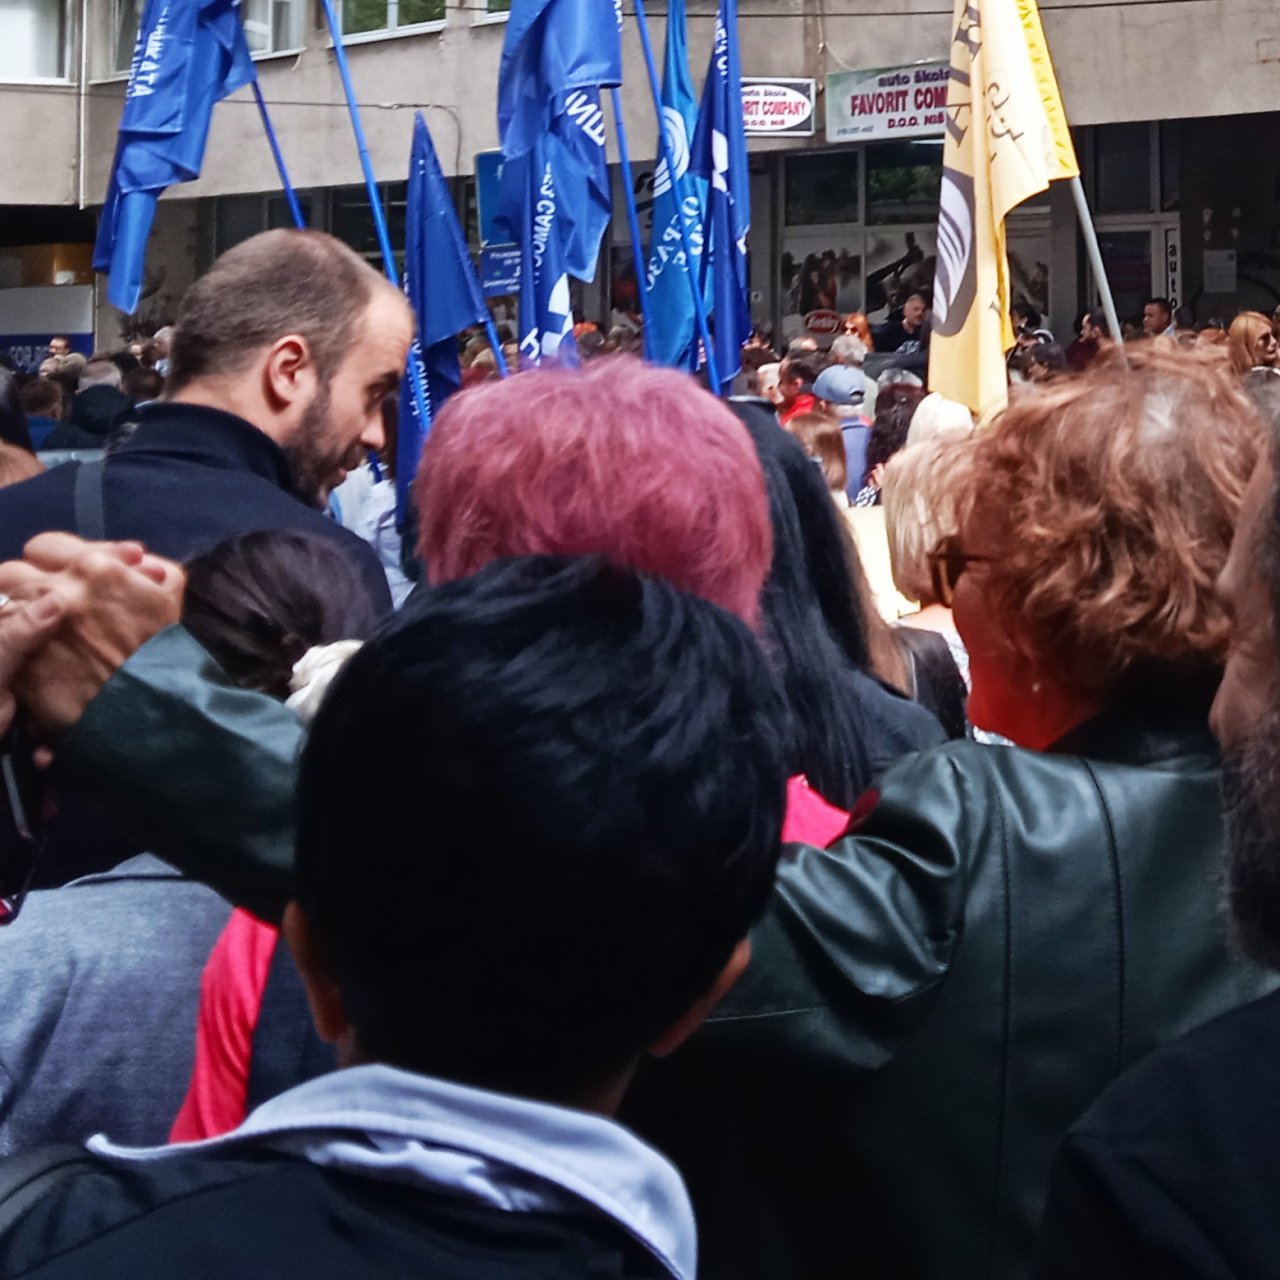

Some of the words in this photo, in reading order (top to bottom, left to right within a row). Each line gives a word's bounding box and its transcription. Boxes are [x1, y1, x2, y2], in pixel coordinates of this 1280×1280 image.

[762, 100, 806, 116] COMPANY
[850, 90, 909, 117] FAVORIT
[914, 86, 948, 110] COM
